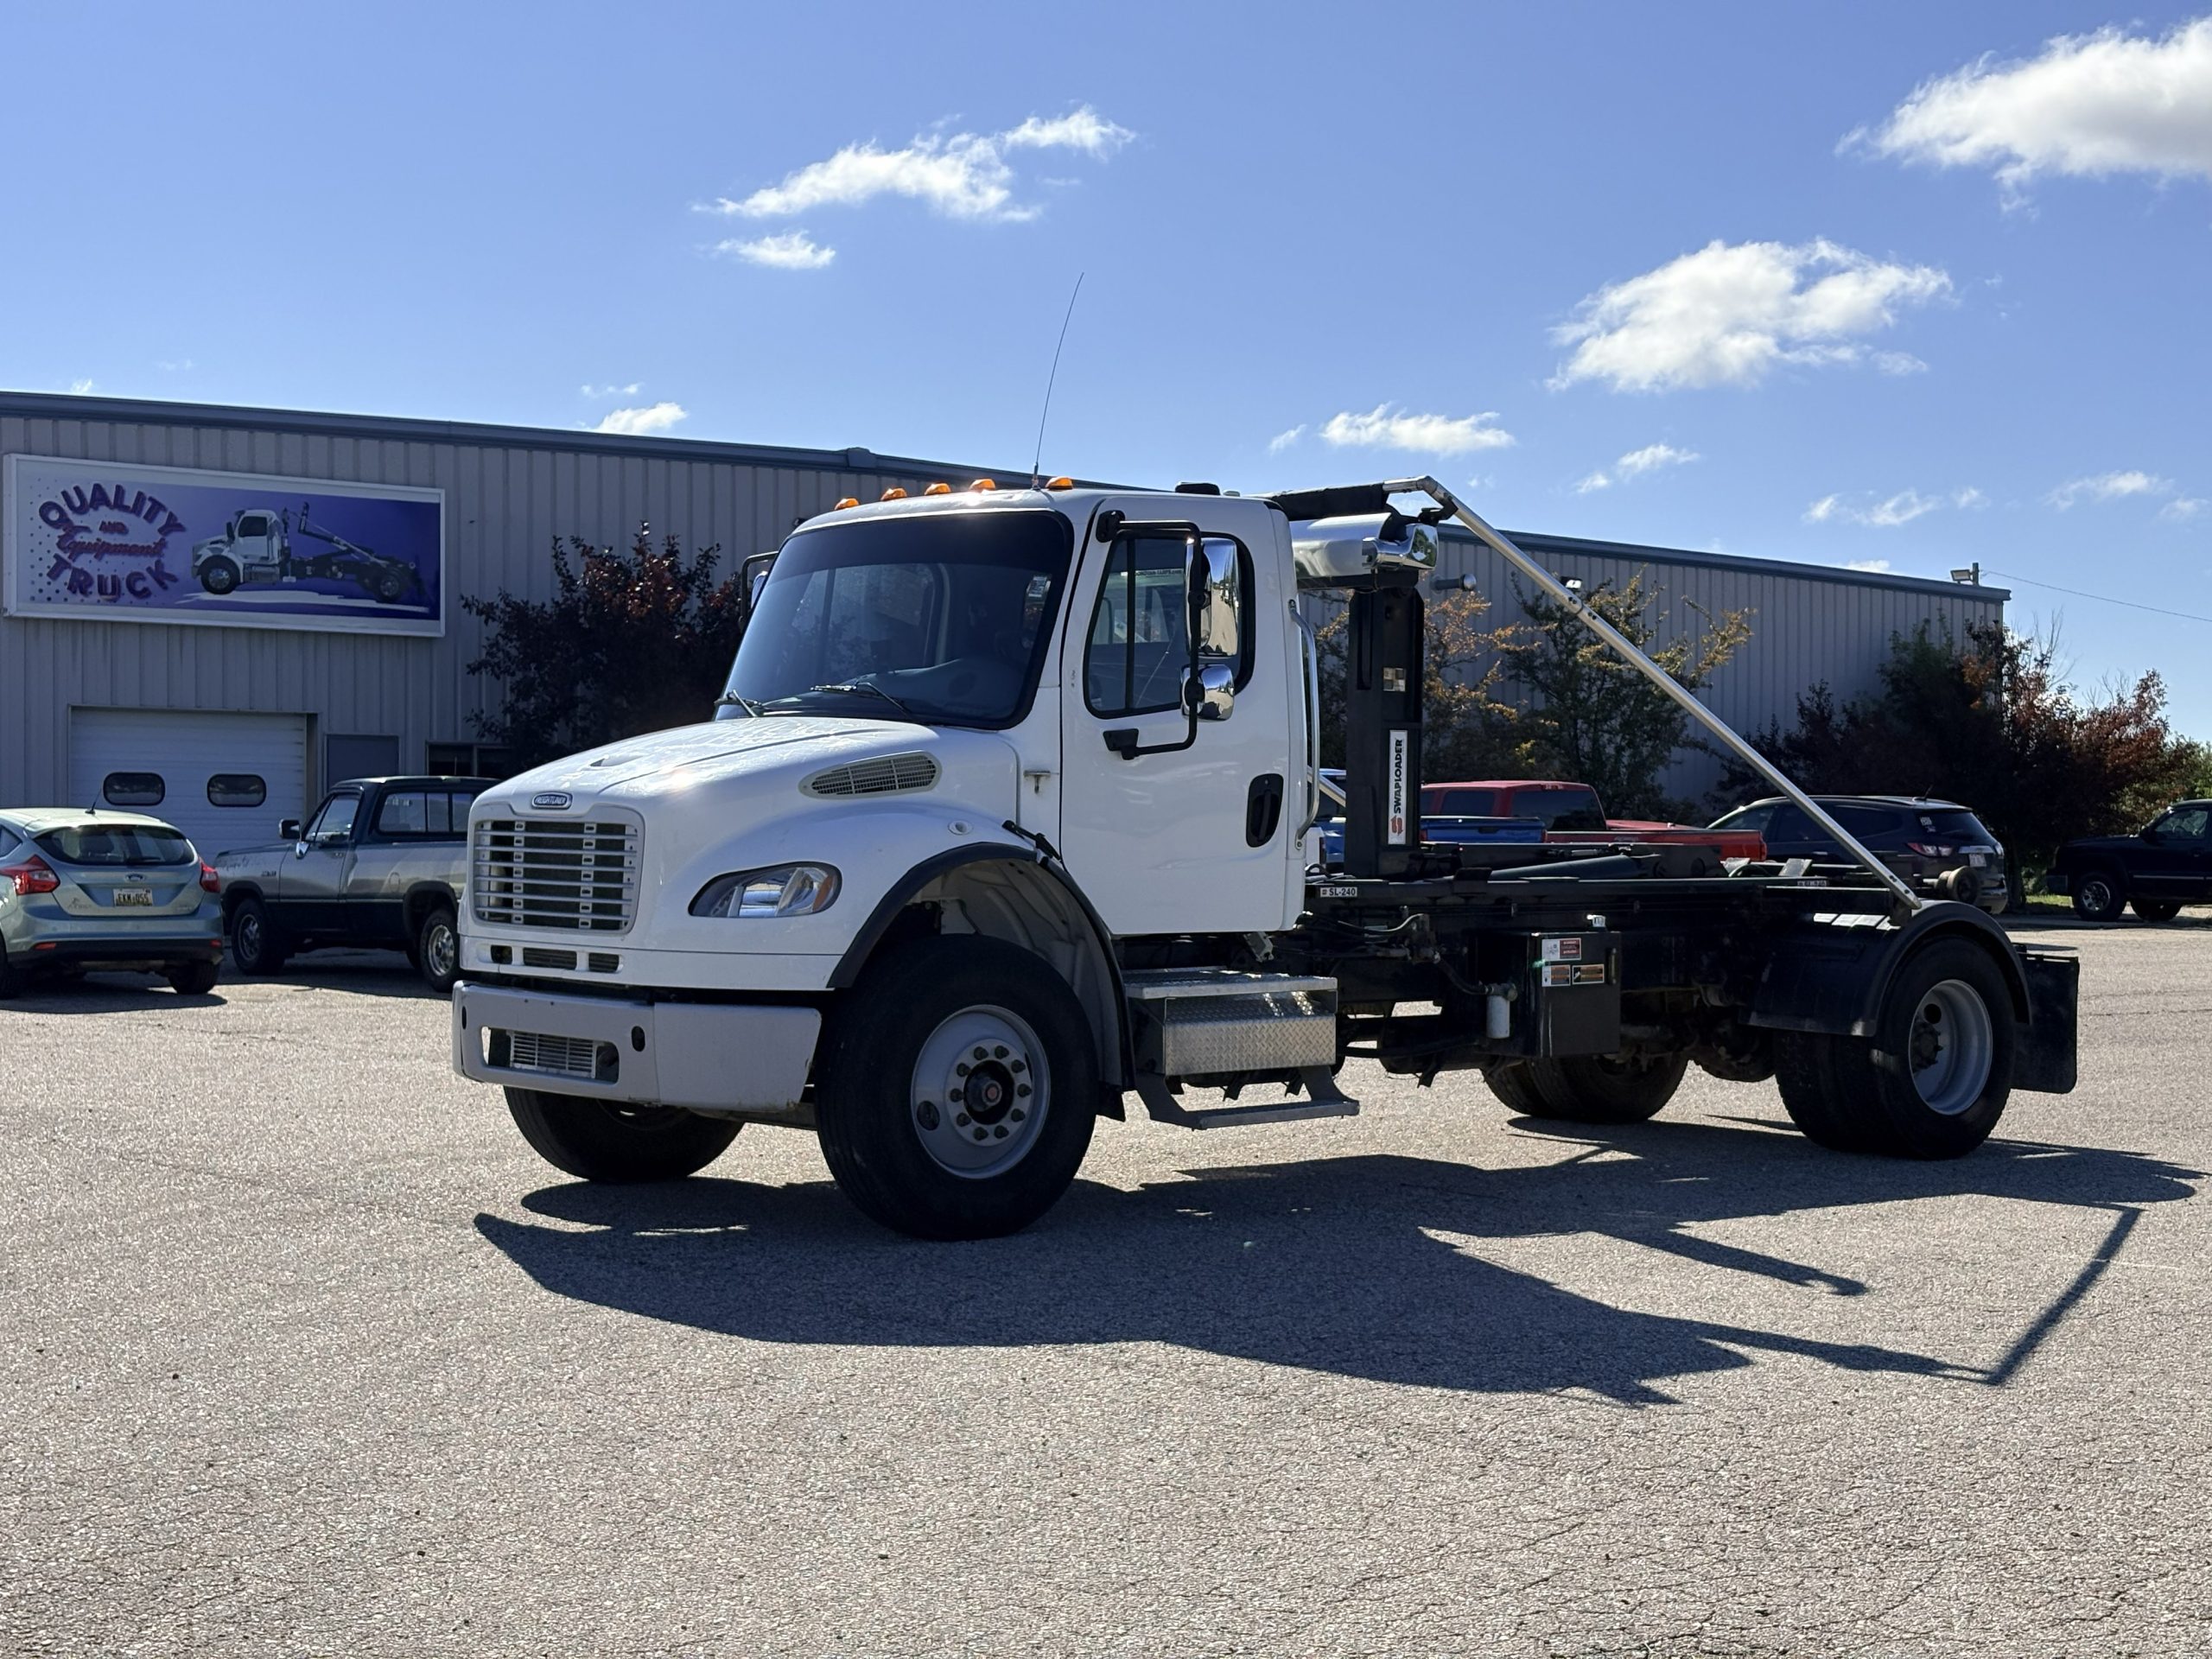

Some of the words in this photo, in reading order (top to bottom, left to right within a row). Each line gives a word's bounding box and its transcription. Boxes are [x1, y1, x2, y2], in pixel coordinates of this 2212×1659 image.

[39, 483, 187, 537] QUALITY
[99, 521, 129, 535] AND
[47, 553, 179, 601] TRUCK
[1394, 739, 1403, 814] SWAPLOADER
[1329, 887, 1356, 896] SL-240
